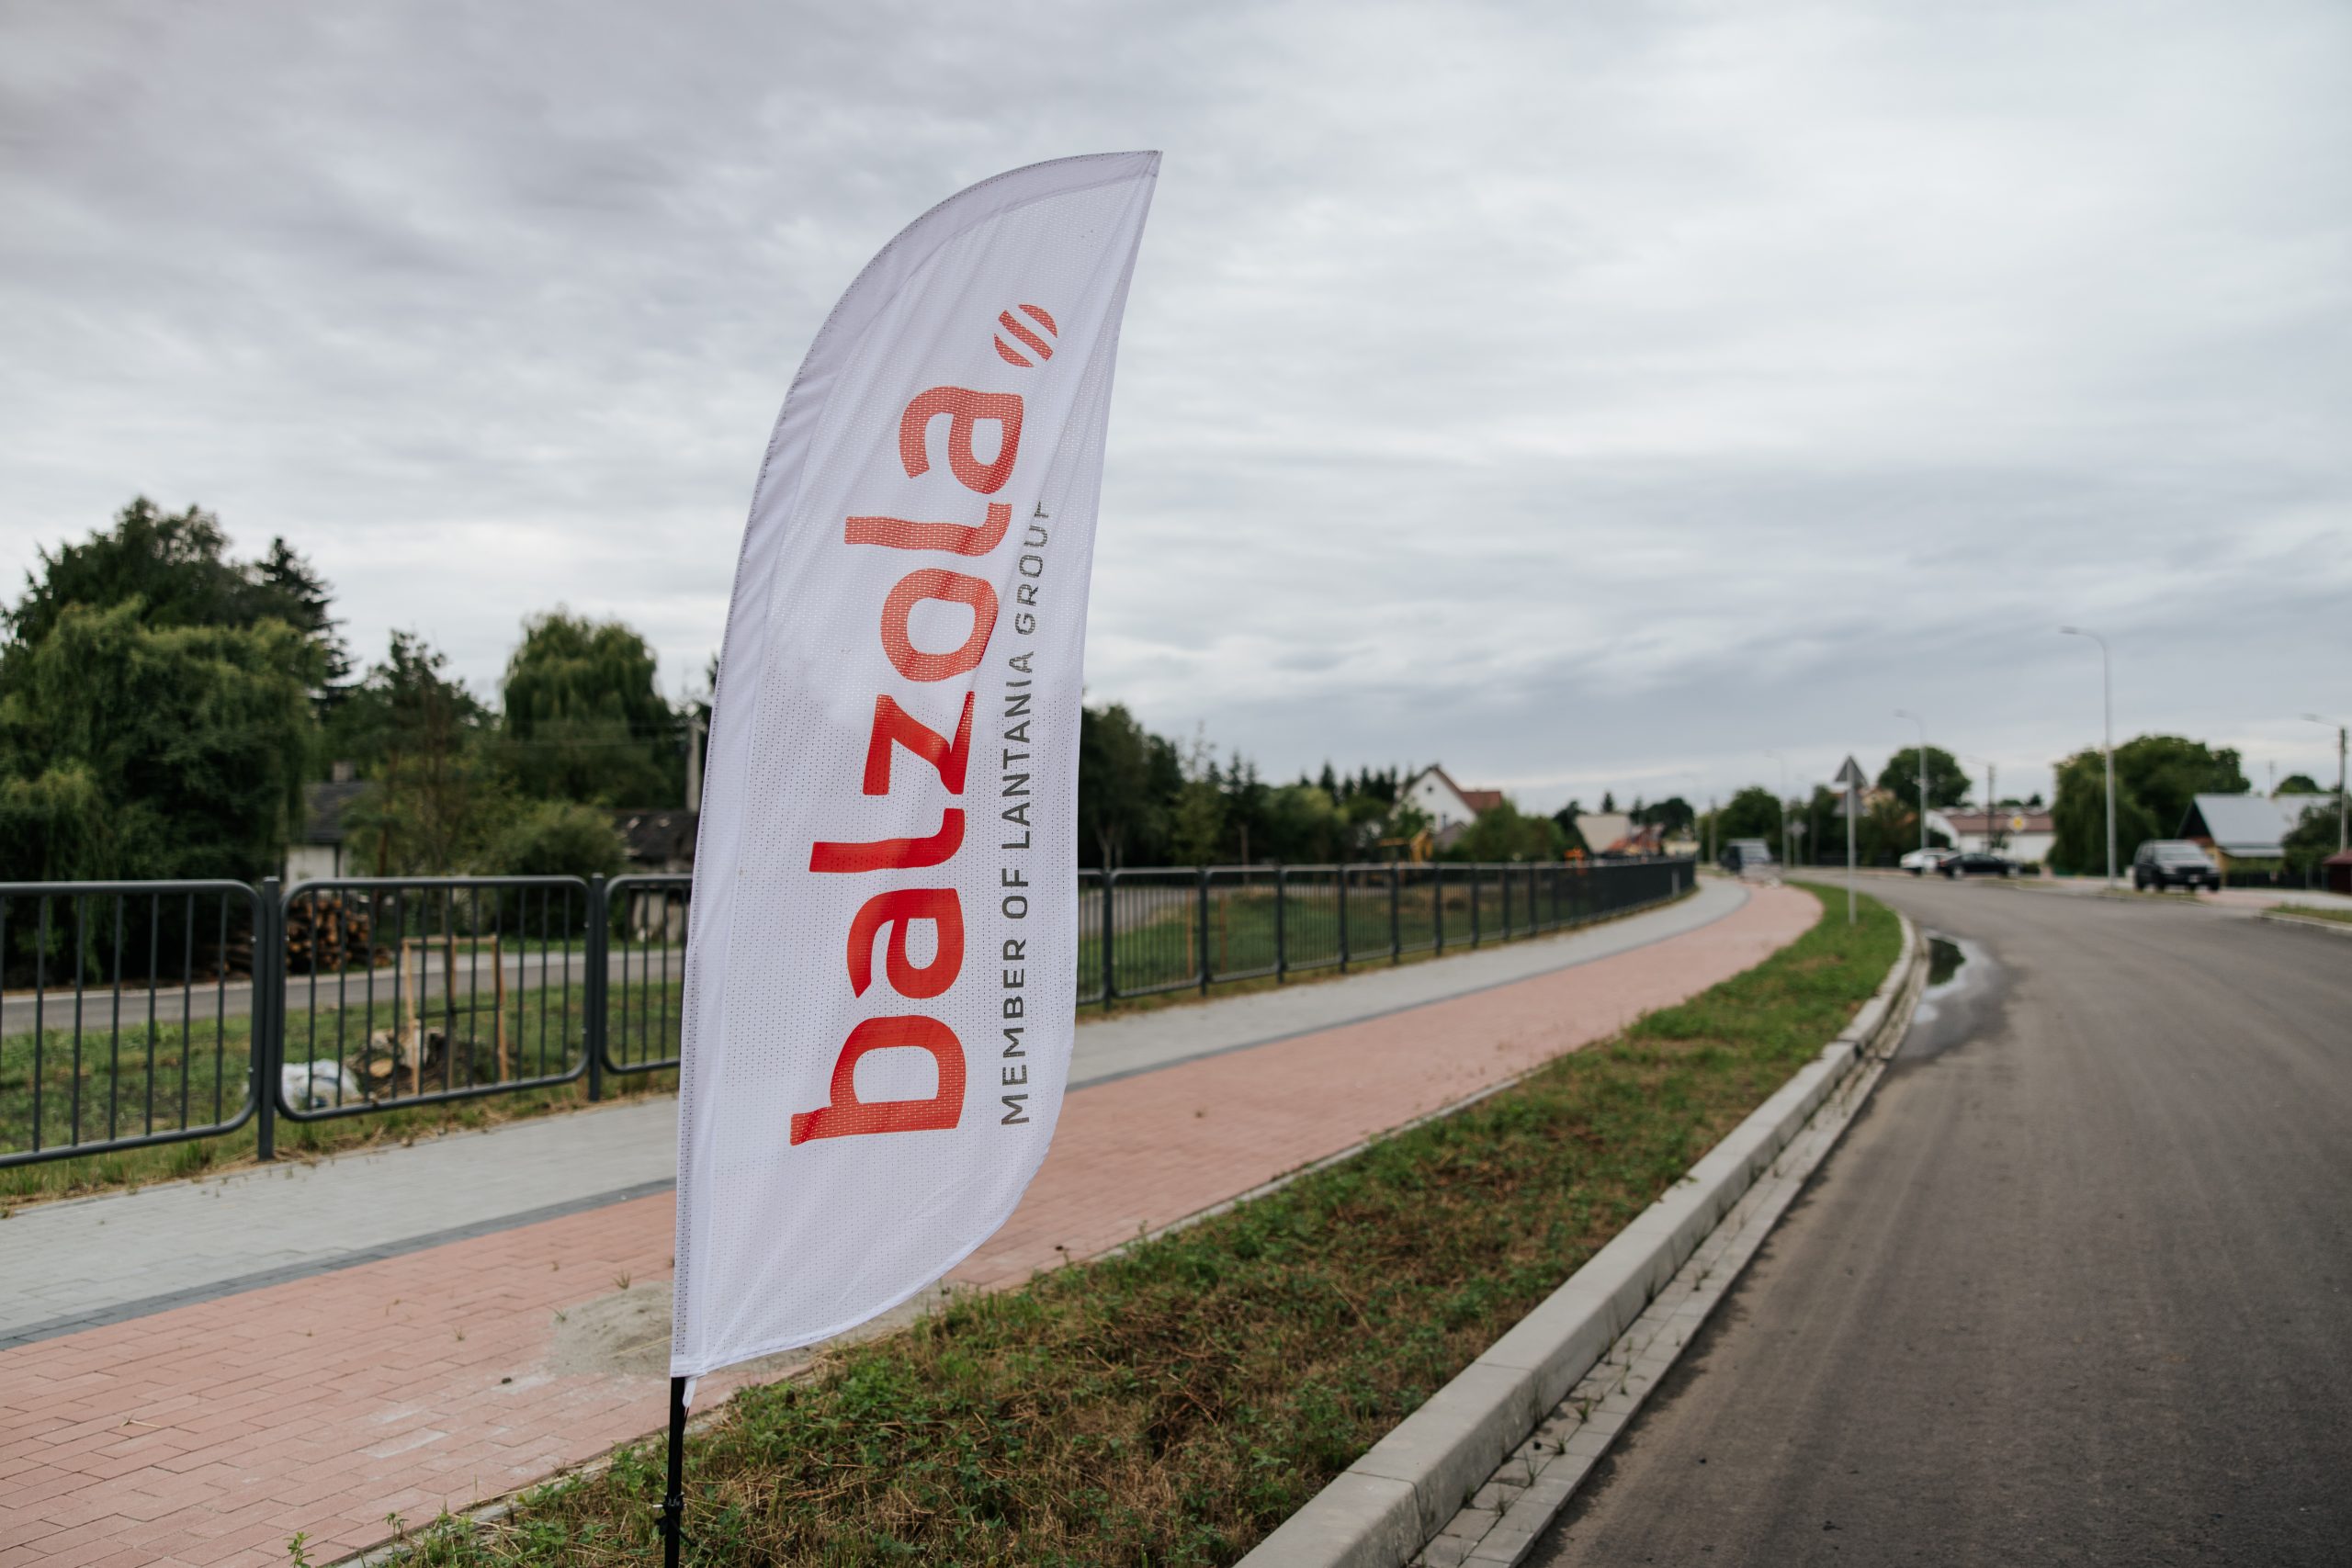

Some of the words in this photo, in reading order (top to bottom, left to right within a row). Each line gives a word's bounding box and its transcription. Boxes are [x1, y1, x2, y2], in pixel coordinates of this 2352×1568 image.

[790, 386, 1023, 1147] balzola
[999, 650, 1035, 852] LANTANIA
[999, 866, 1029, 919] OF
[1001, 936, 1030, 1126] MEMBER
